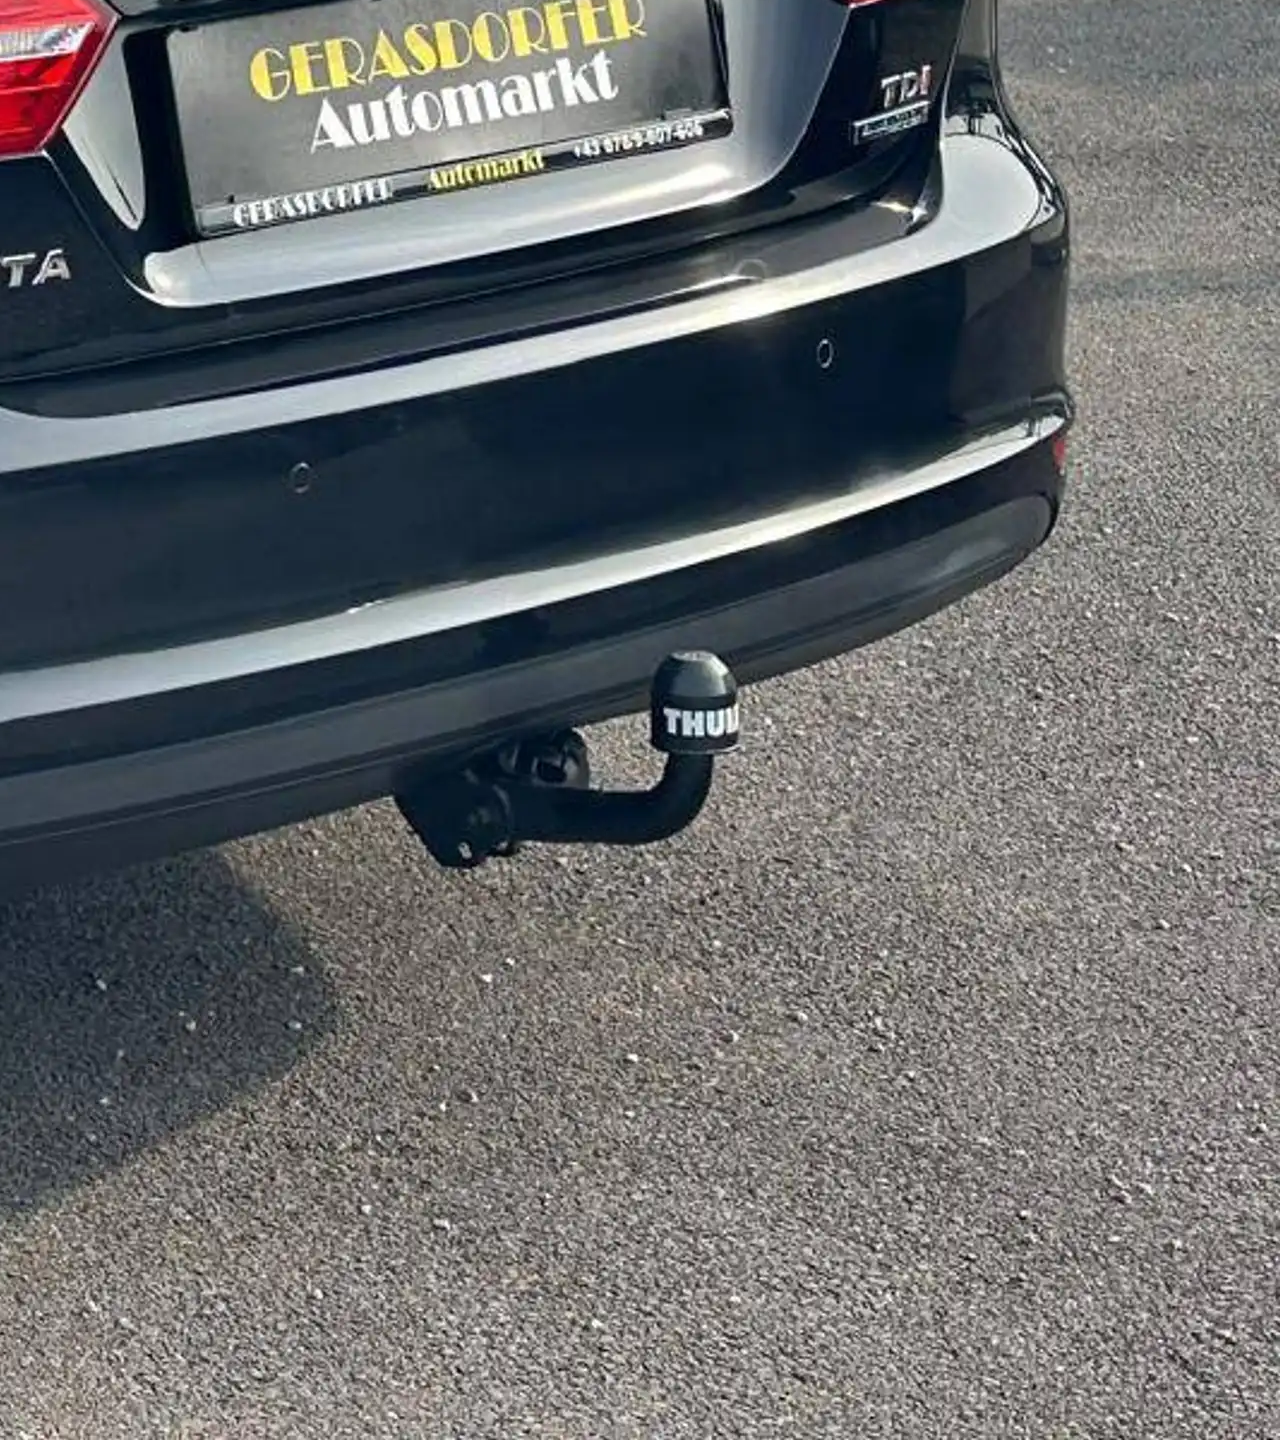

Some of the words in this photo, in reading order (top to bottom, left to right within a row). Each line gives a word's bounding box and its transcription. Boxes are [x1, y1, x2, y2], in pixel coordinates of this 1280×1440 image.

[309, 49, 621, 155] Automarkt
[881, 64, 931, 108] TDI
[426, 148, 546, 194] Automarkt
